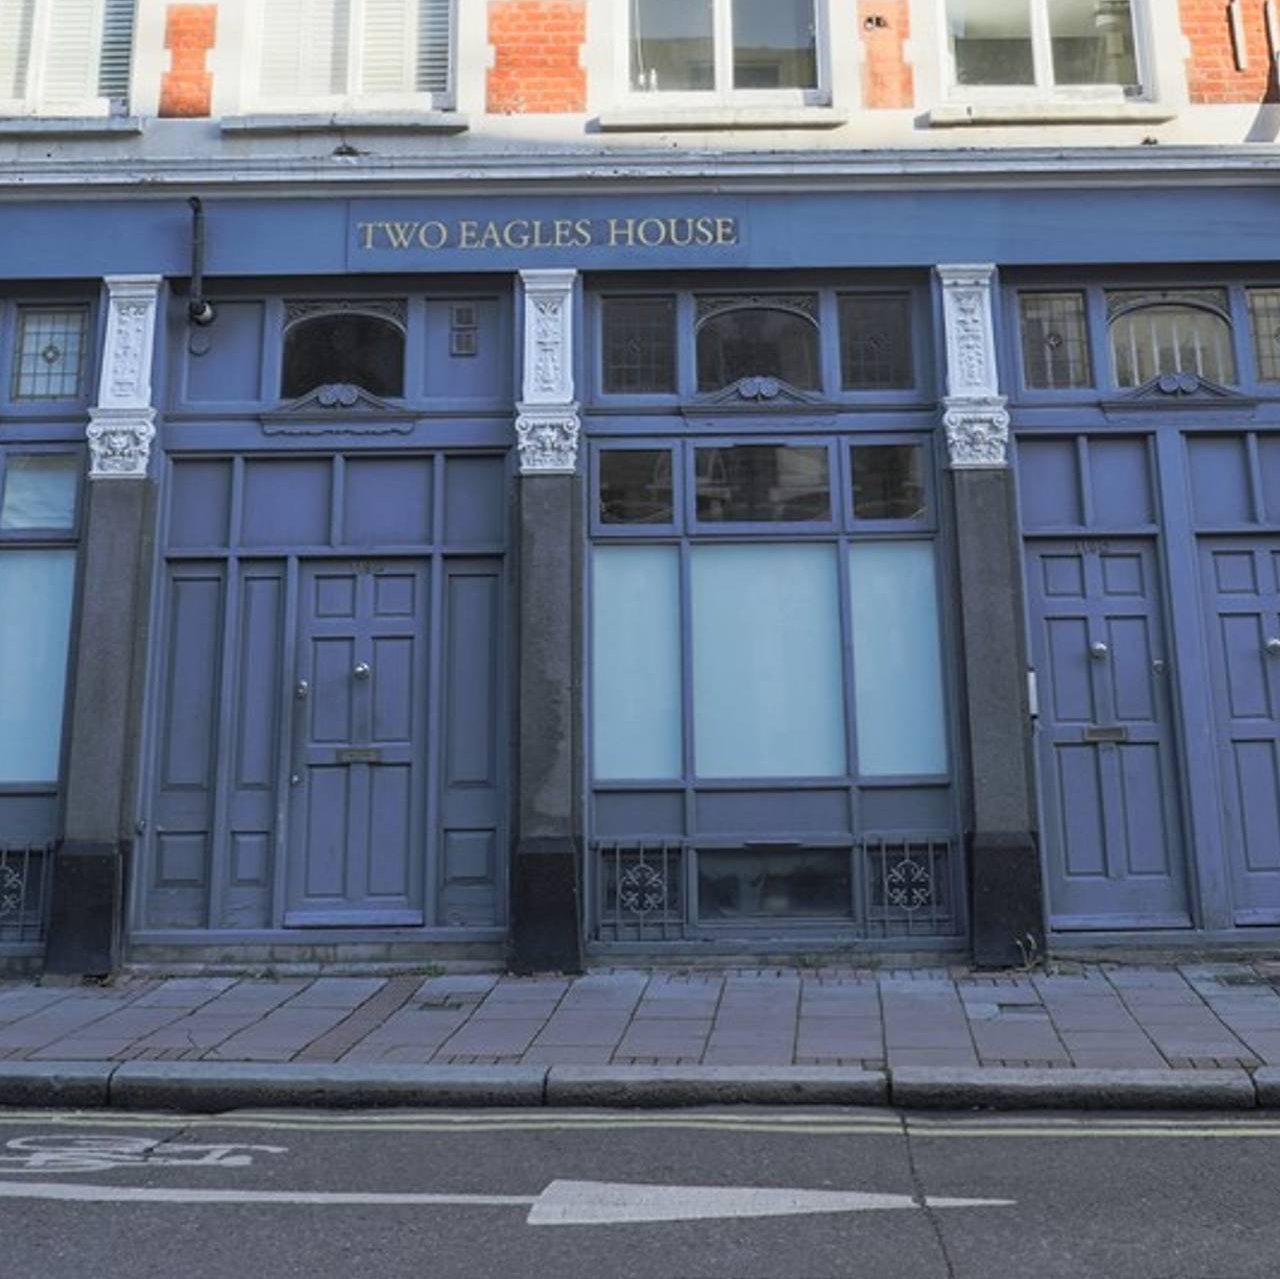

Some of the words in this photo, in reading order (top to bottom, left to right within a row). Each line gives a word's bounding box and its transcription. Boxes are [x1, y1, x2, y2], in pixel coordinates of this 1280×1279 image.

[357, 220, 449, 250] TWO
[457, 218, 593, 249] EAGLES
[607, 217, 737, 247] HOUSE
